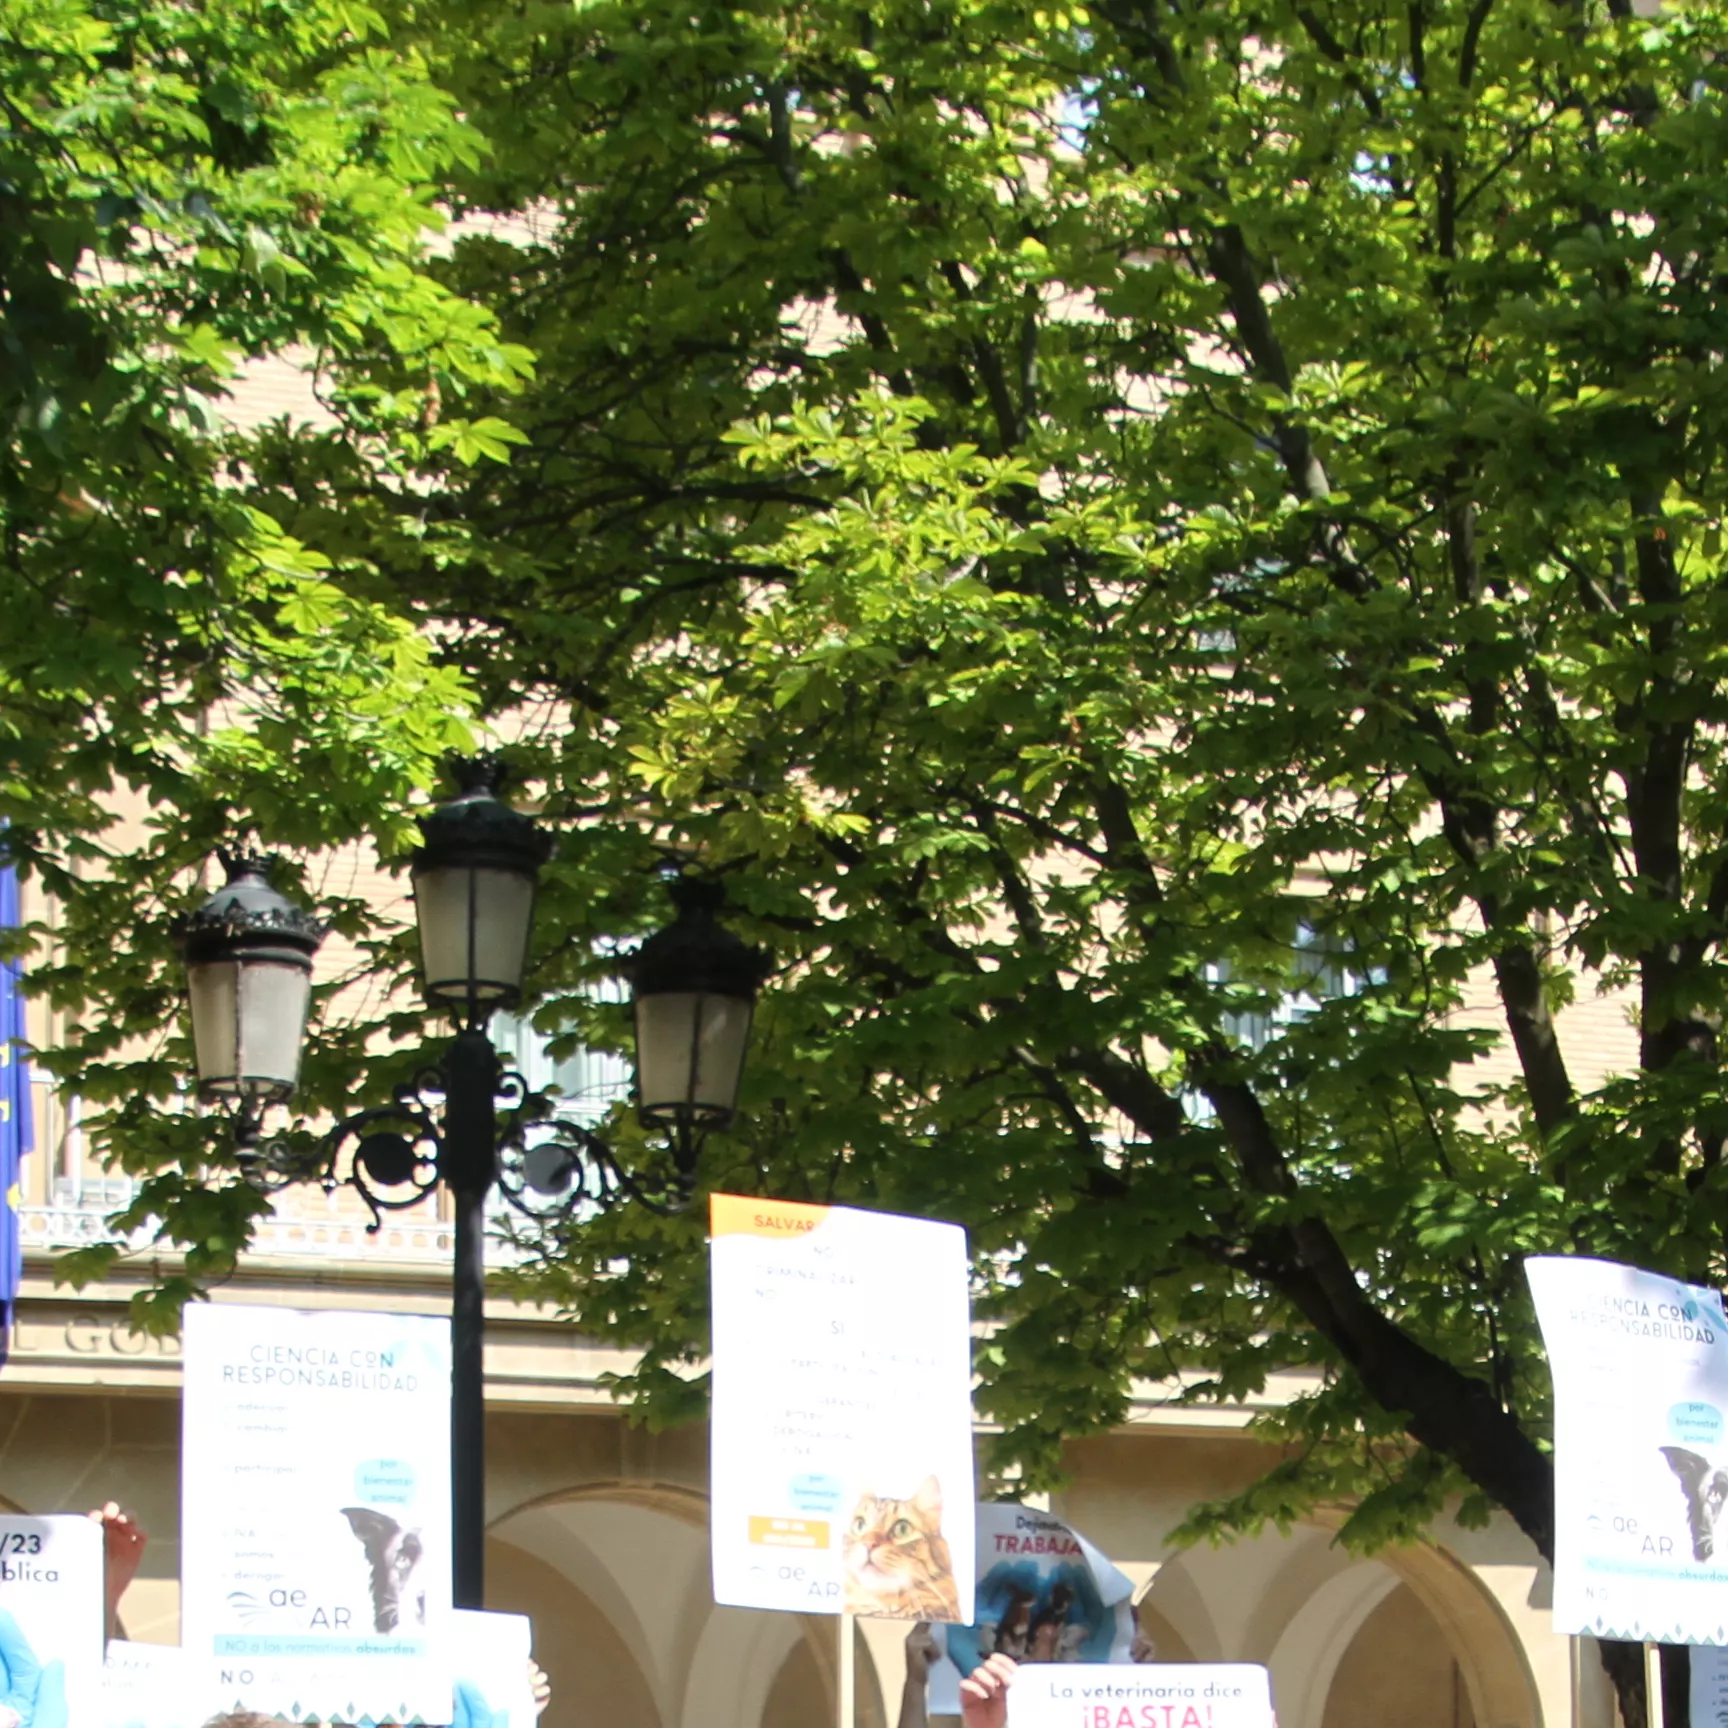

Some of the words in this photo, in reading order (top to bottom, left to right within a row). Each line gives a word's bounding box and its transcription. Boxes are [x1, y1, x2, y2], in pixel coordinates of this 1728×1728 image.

[753, 1213, 816, 1233] SALVAR
[1658, 1303, 1693, 1323] CON
[250, 1345, 339, 1367] CIENCIA
[349, 1350, 395, 1369] CON
[222, 1365, 418, 1392] RESPONSABILIDAD
[269, 1588, 307, 1607] ae
[225, 1640, 247, 1652] NO
[355, 1641, 417, 1655] absurdas
[220, 1669, 254, 1685] NO
[1050, 1682, 1073, 1698] La
[1081, 1681, 1195, 1699] veterinaria
[1203, 1681, 1242, 1699] dice
